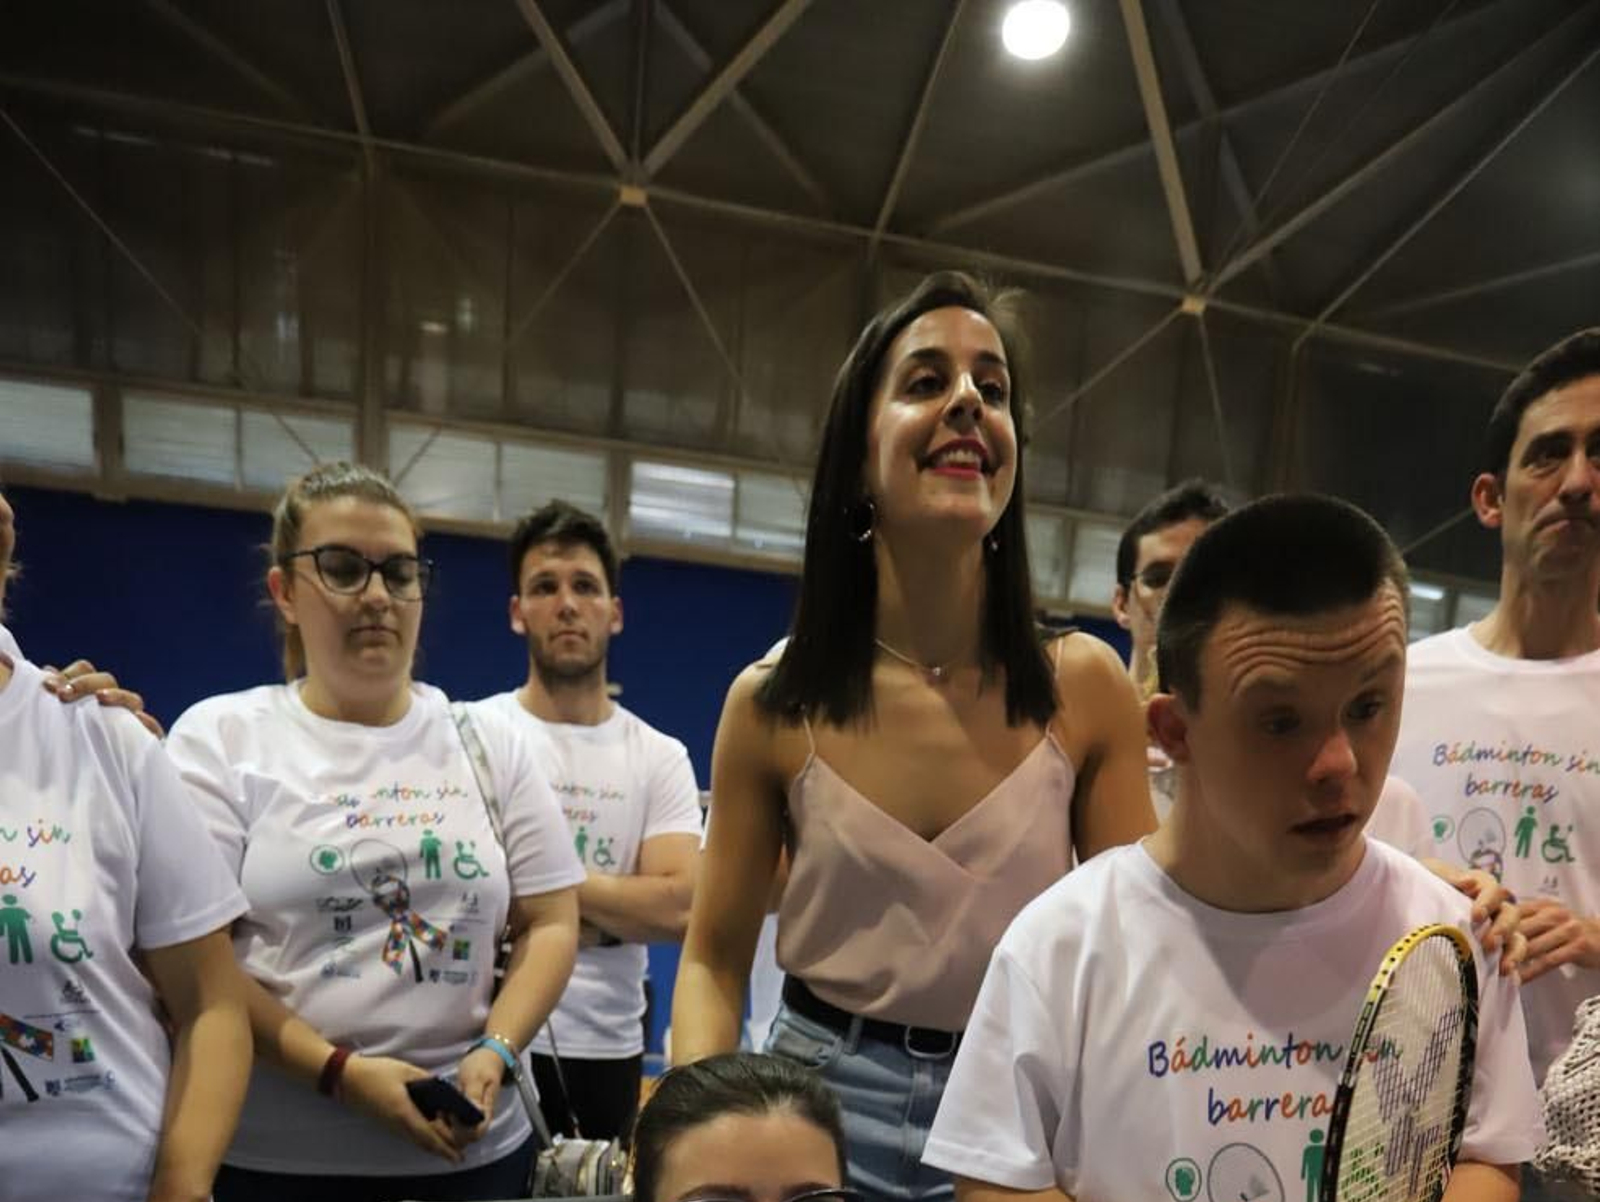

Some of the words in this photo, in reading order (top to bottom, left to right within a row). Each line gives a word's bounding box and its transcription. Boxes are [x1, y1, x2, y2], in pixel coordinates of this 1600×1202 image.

[1465, 773, 1559, 803] barreras
[27, 818, 71, 847] sin
[1148, 1032, 1343, 1077] Bádminton
[1207, 1087, 1334, 1126] barrera
